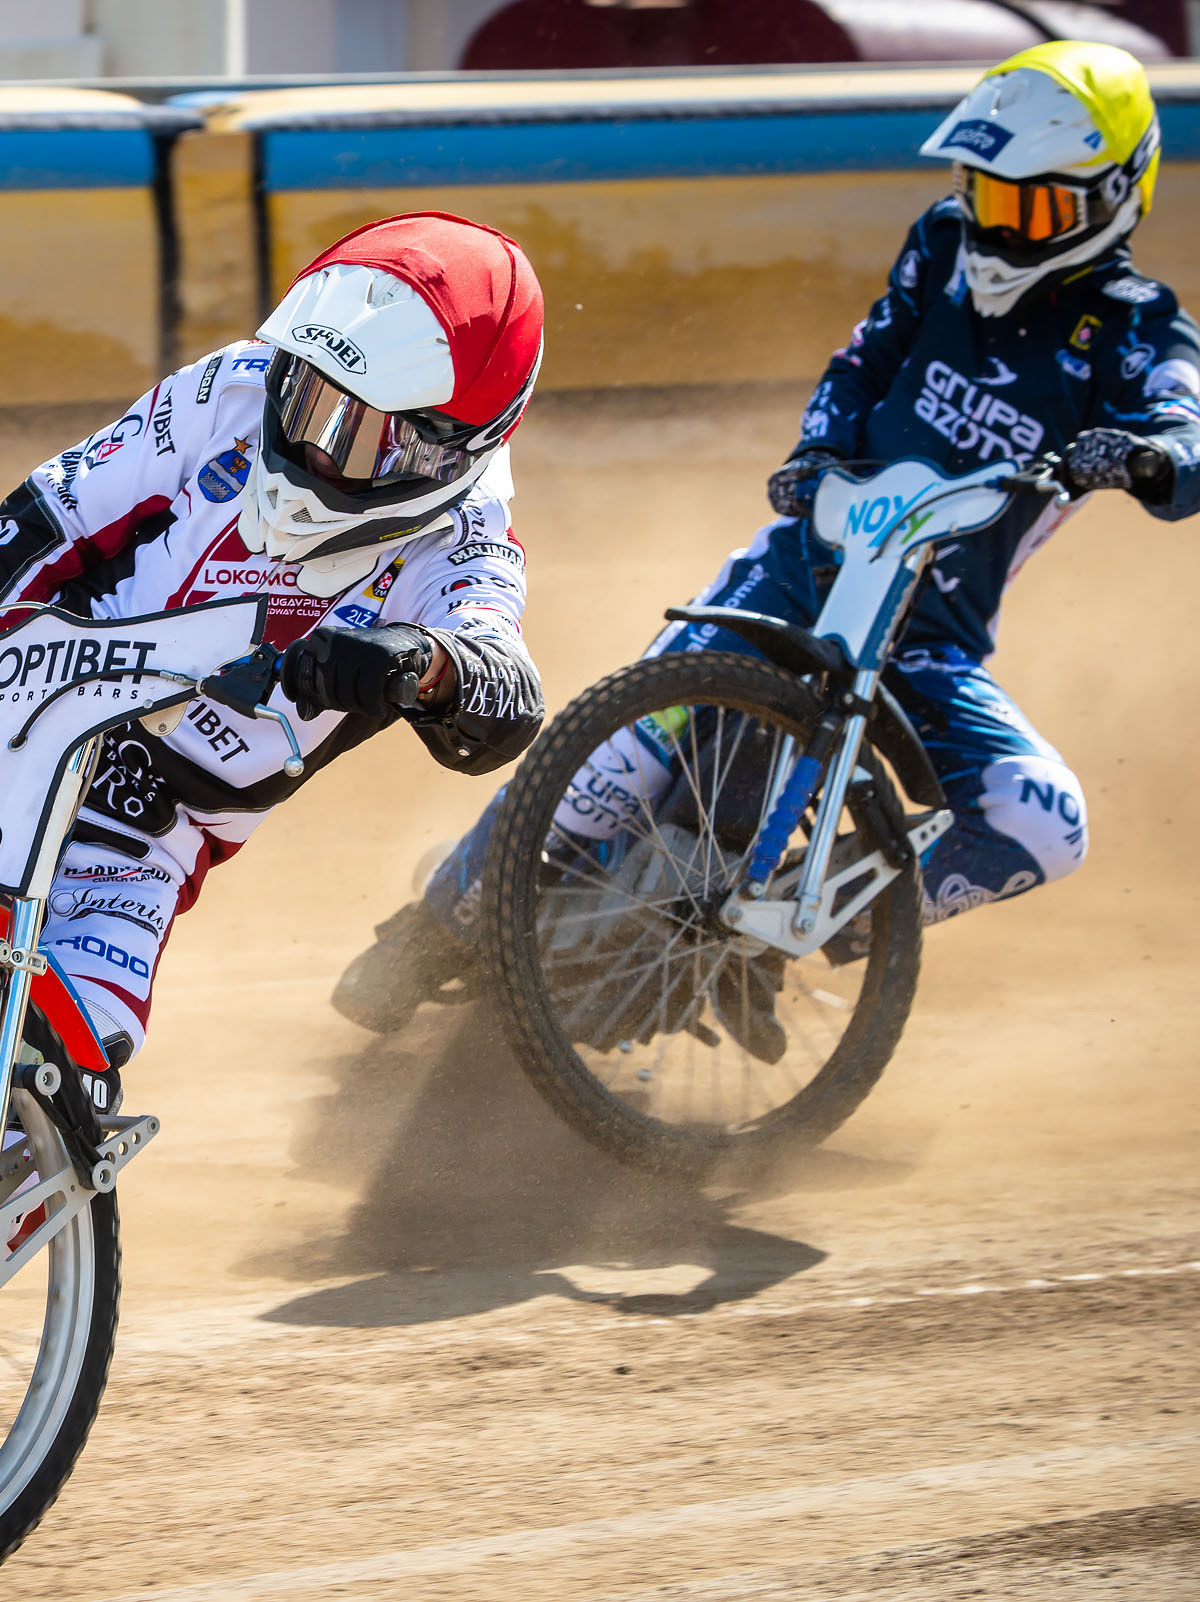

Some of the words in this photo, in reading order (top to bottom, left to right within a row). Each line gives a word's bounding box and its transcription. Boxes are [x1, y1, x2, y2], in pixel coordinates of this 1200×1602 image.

[299, 327, 361, 368] SHOEI
[154, 386, 176, 456] TIBET
[204, 569, 297, 586] LOKOMO
[296, 609, 321, 617] CLUB
[187, 700, 250, 763] IBET
